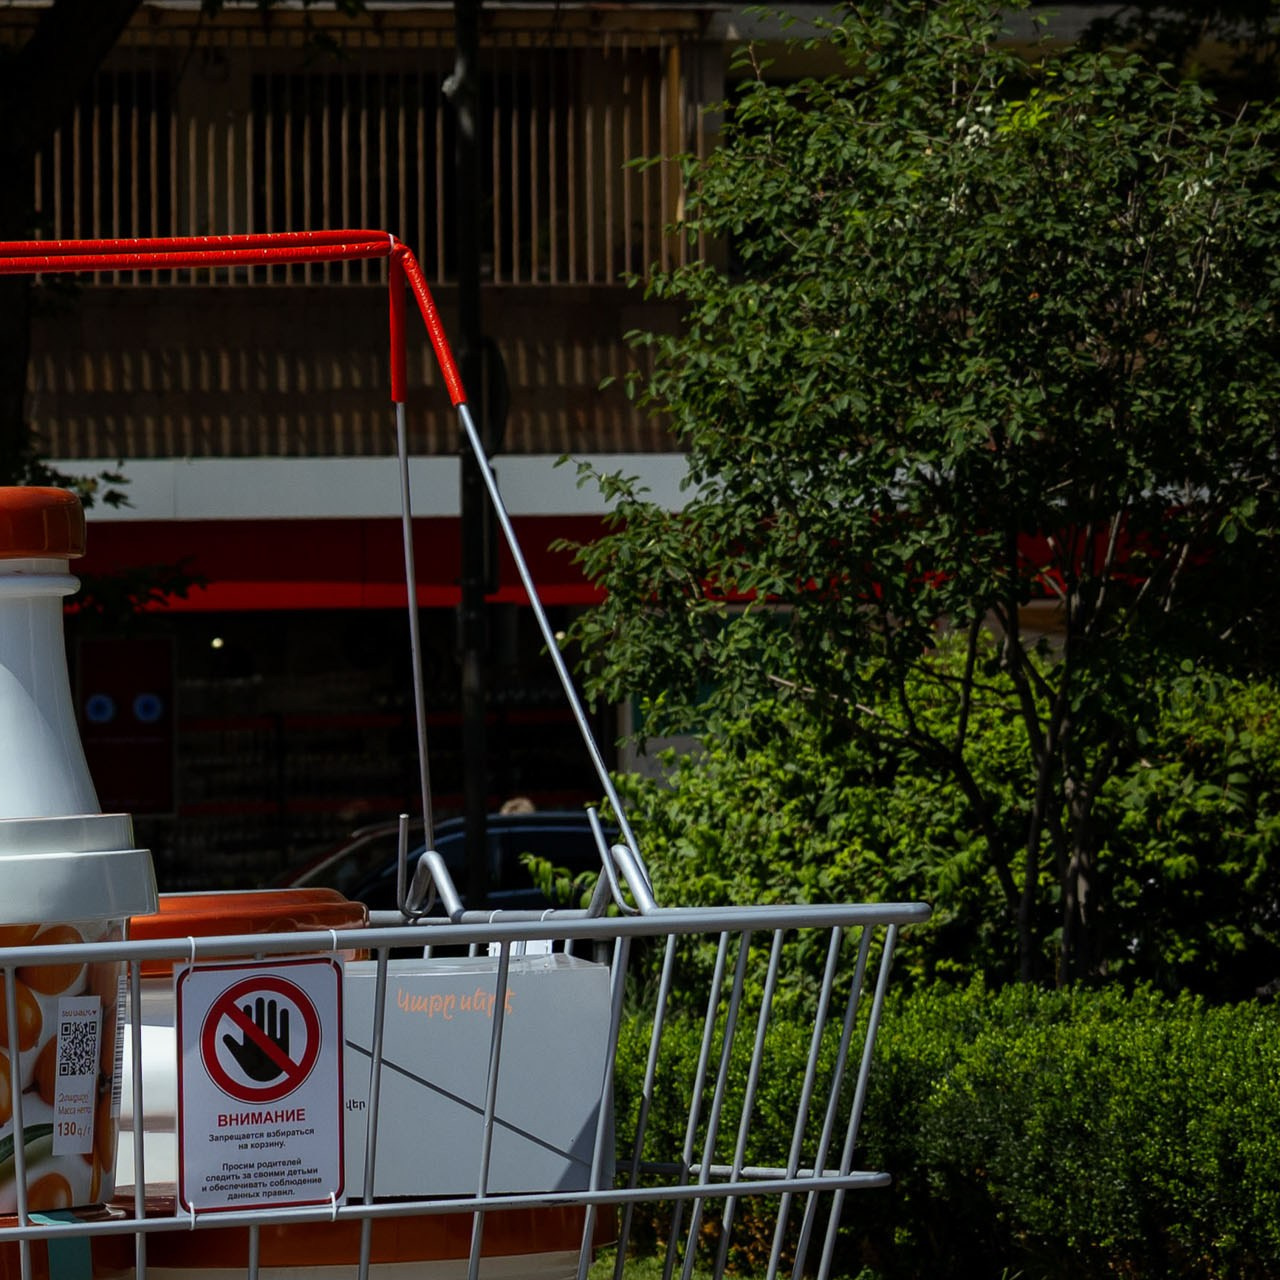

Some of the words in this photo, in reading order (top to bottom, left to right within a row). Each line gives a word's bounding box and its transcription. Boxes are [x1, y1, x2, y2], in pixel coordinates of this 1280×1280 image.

[396, 987, 456, 1020] Կաթը
[217, 1108, 306, 1127] ВНИМАНИЕ
[57, 1121, 77, 1137] 130
[208, 1130, 265, 1143] Запрещается
[266, 1127, 315, 1139] взбираться
[238, 1142, 248, 1150] на
[250, 1140, 286, 1151] корзину.
[222, 1161, 255, 1172] Просим
[256, 1157, 302, 1170] родителей
[205, 1172, 241, 1183] следить
[242, 1172, 252, 1180] за
[253, 1170, 286, 1180] своими
[287, 1167, 318, 1178] детьми
[208, 1179, 268, 1192] обеспечивать
[269, 1176, 322, 1189] соблюдение
[227, 1191, 261, 1201] данных
[262, 1188, 295, 1199] правил.
